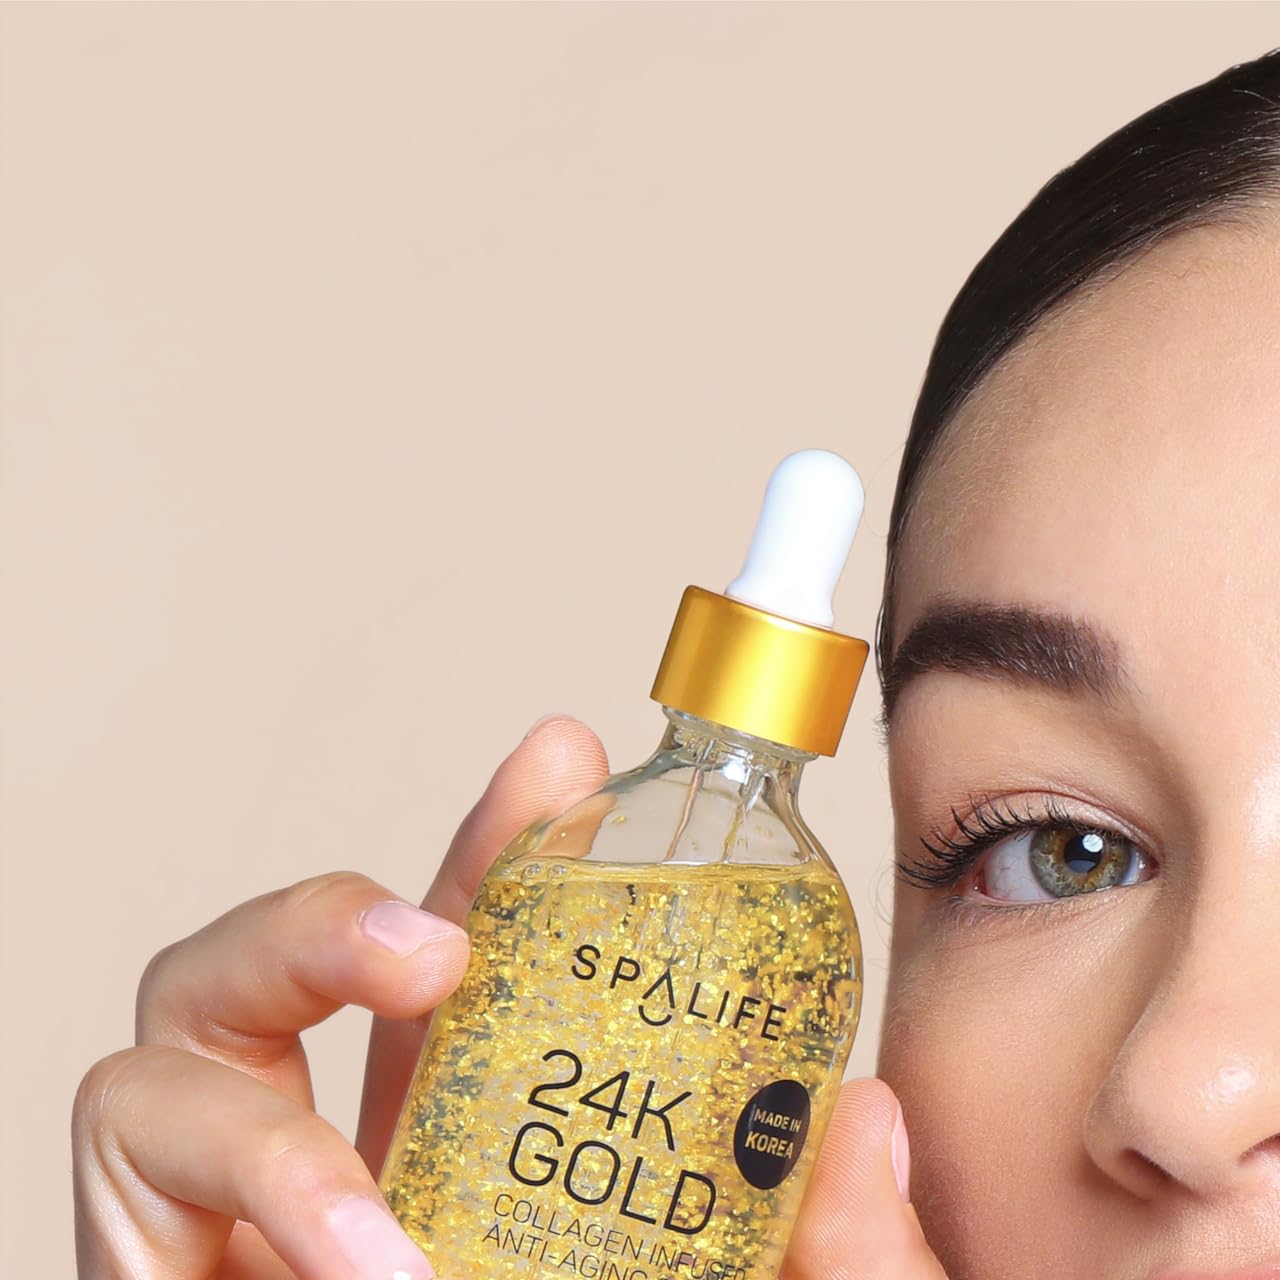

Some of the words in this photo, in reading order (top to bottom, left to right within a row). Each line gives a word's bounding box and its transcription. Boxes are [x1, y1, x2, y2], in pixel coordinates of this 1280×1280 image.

[571, 944, 787, 1041] SPALIFE
[527, 1048, 693, 1152] 24K
[754, 1108, 790, 1130] MADE
[790, 1117, 802, 1133] IN
[508, 1121, 717, 1236] GOLD
[745, 1131, 794, 1159] KOREA
[493, 1193, 643, 1261] COLLAGEN
